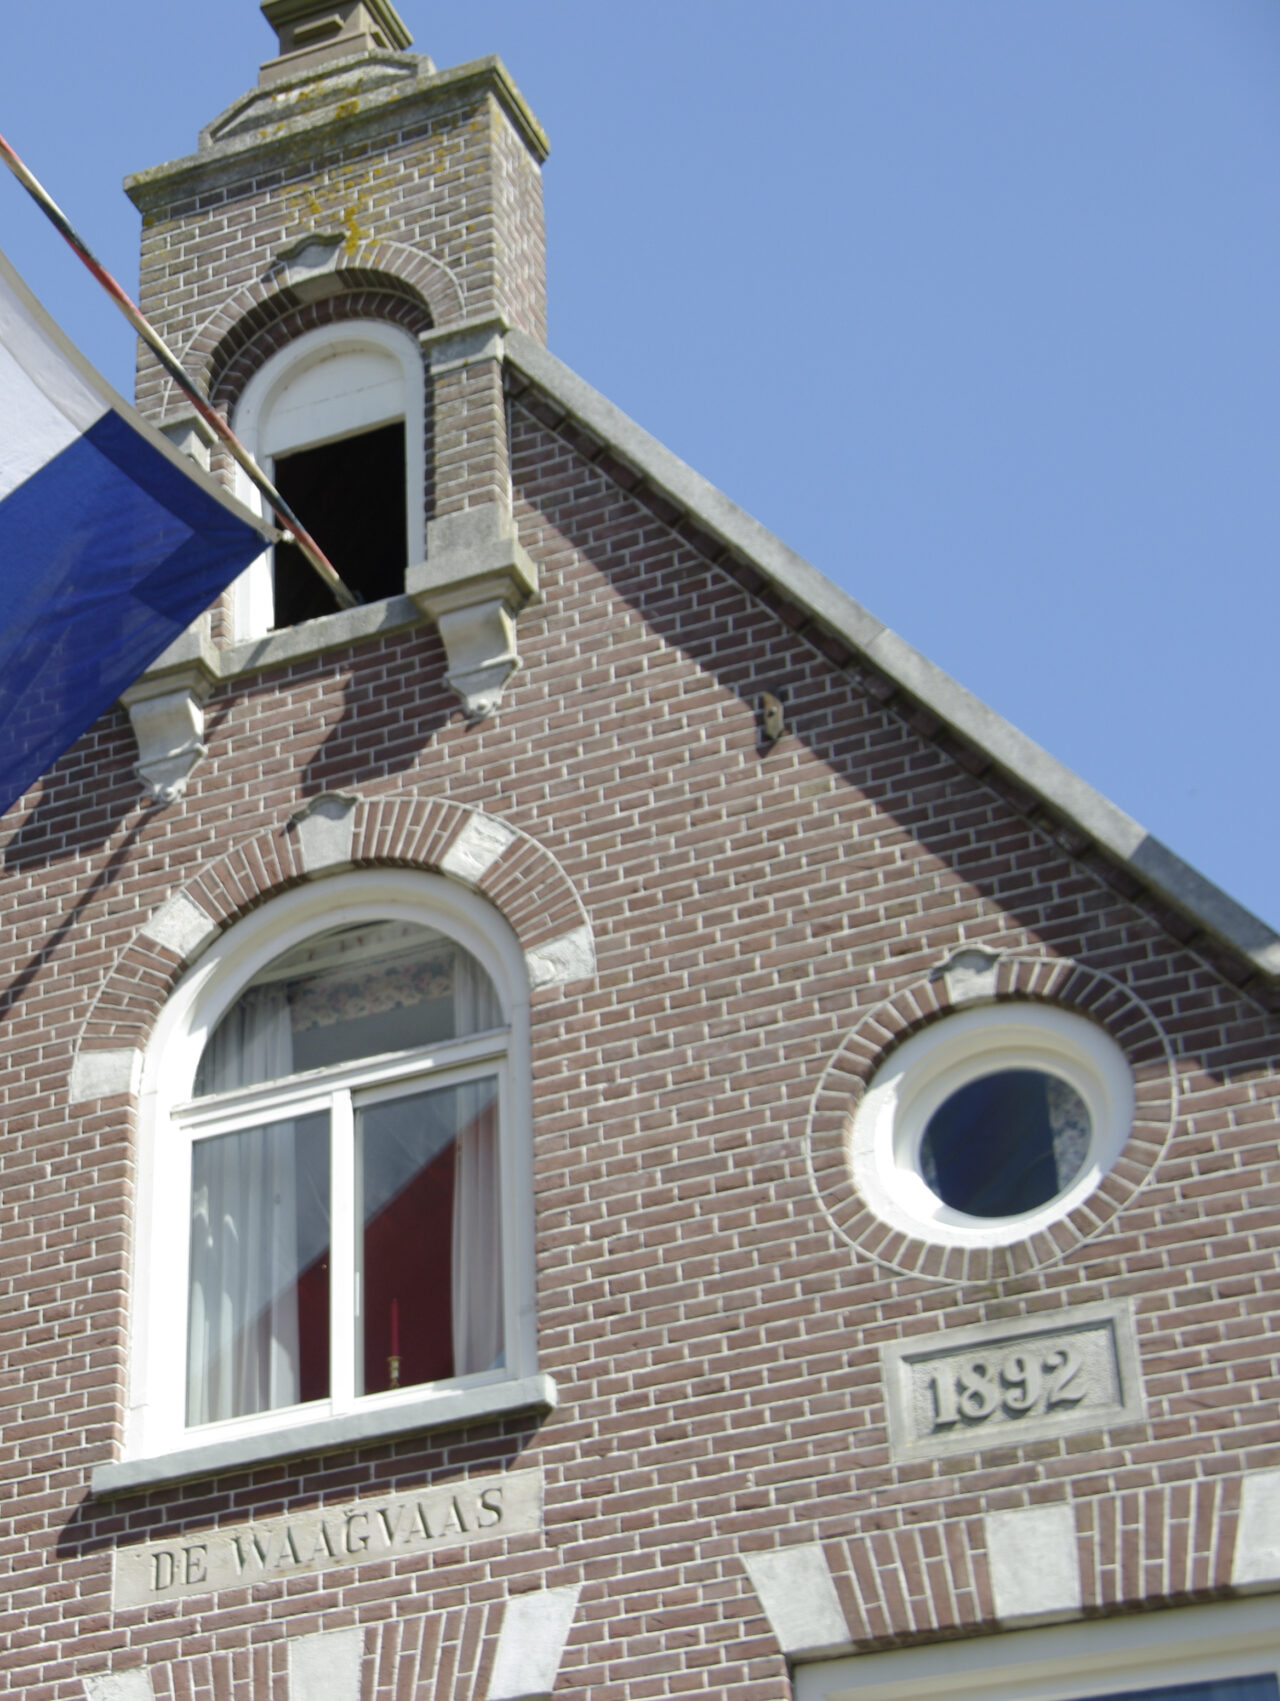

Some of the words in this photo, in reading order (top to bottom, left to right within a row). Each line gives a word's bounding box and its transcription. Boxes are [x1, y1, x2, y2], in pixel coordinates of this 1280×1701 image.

[930, 1349, 1087, 1427] 1892
[150, 1543, 208, 1592] DE
[231, 1486, 504, 1577] WAAGVAAS
